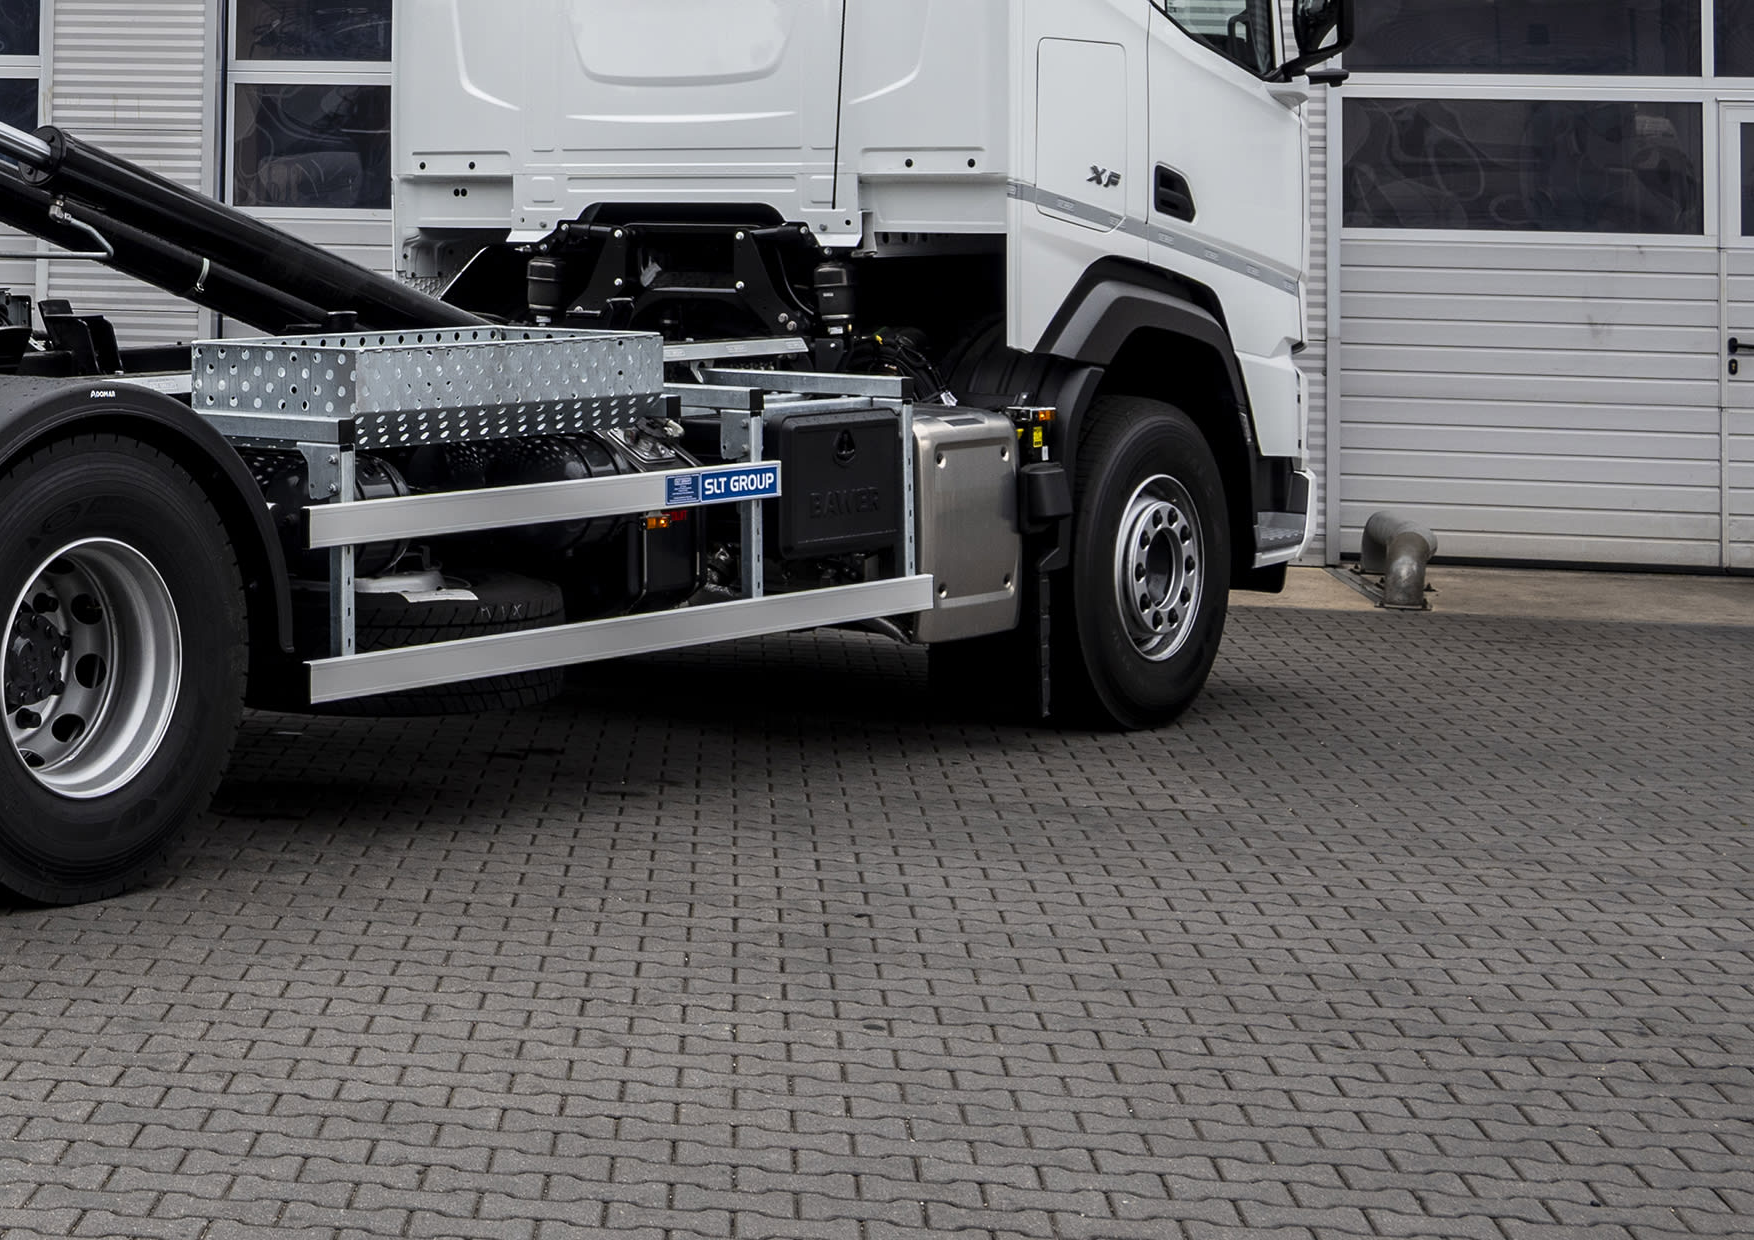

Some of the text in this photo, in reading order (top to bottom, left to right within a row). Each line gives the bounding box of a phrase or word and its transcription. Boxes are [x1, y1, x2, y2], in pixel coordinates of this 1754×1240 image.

[1086, 164, 1122, 188] XF
[704, 477, 727, 495] SLT
[730, 472, 775, 492] GROUP
